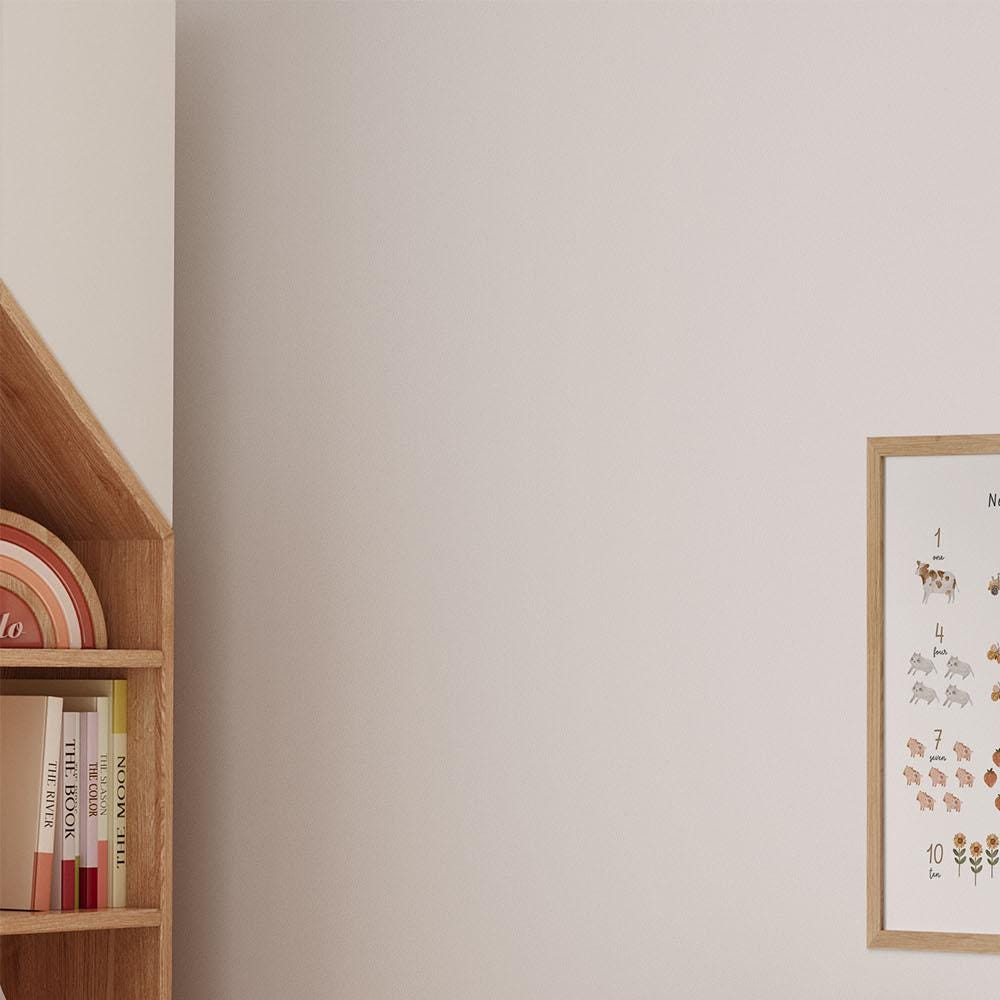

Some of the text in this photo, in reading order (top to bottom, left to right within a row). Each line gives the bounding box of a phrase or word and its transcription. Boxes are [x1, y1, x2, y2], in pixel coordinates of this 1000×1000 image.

[934, 527, 942, 548] 1
[935, 623, 944, 643] 4
[932, 648, 949, 657] four
[933, 729, 943, 750] 7
[65, 739, 76, 779] THE
[929, 754, 947, 762] seven
[43, 761, 58, 828] THE RIVER
[88, 762, 99, 818] THE COLOR
[99, 776, 109, 816] SEASON
[64, 784, 76, 839] BOOK
[116, 756, 127, 869] THE MOON
[926, 843, 944, 865] 10
[929, 867, 941, 879] ten
